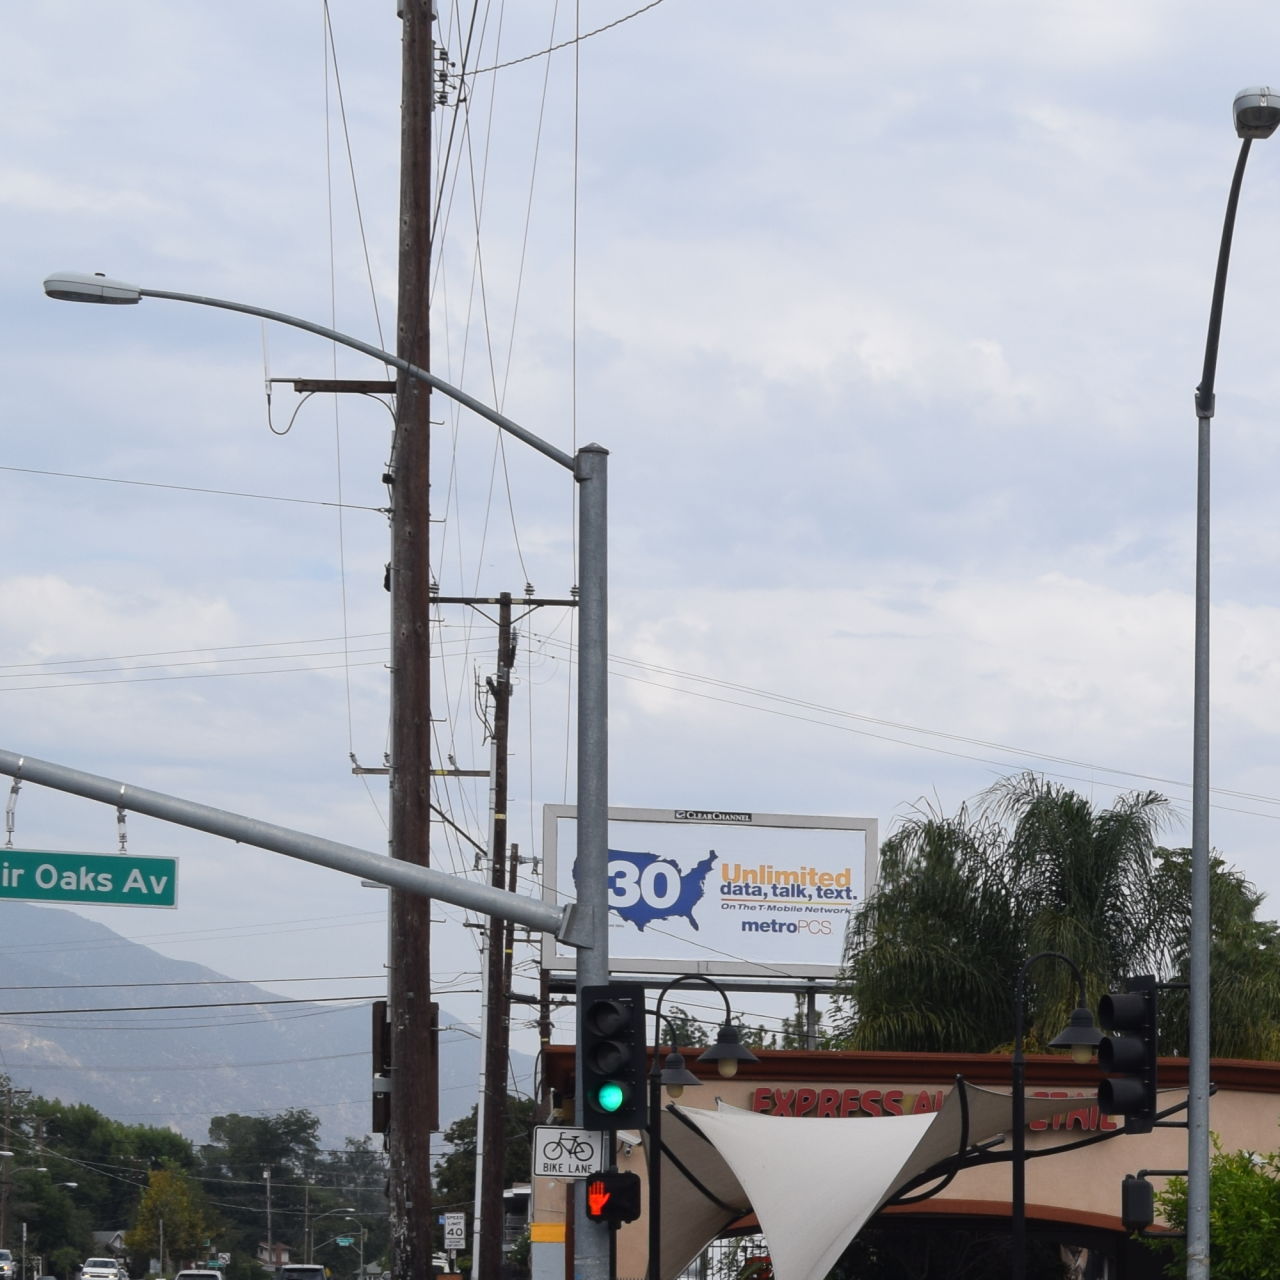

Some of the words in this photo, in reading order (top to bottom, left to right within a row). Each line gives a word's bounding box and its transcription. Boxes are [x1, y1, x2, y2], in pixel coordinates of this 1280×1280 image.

[35, 863, 113, 892] Oaks
[121, 868, 168, 894] Av
[721, 863, 851, 888] Unlimited
[720, 881, 768, 900] data,
[771, 883, 813, 902] talk,
[816, 885, 858, 900] text.
[759, 904, 803, 913] T-Mobile
[805, 906, 851, 915] Network
[741, 919, 832, 935] metroPCS
[543, 1162, 564, 1173] BIKE
[568, 1163, 593, 1174] LANE
[446, 1228, 463, 1237] 40
